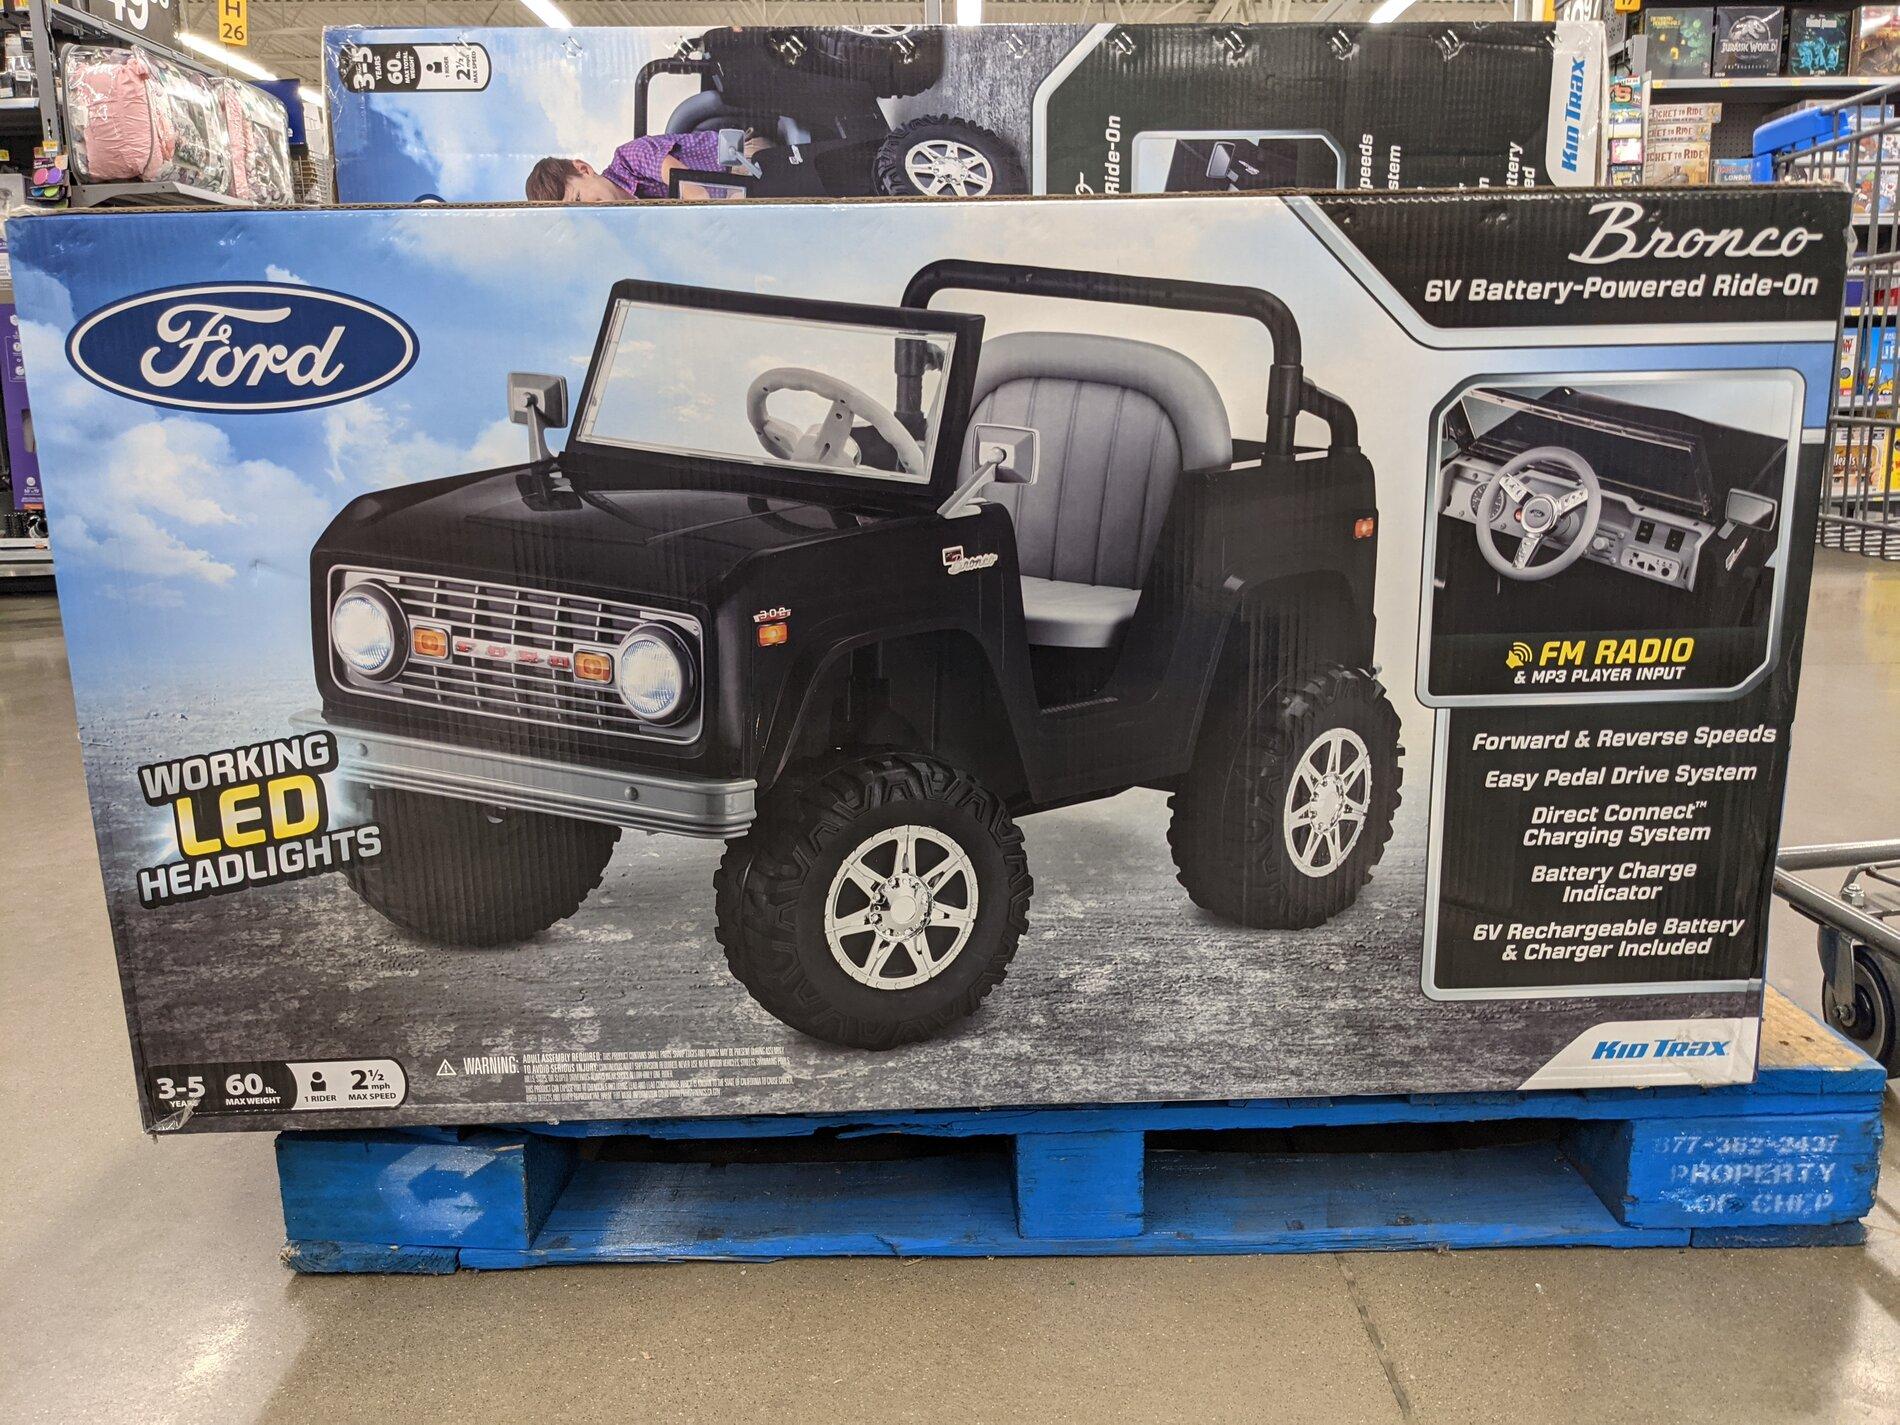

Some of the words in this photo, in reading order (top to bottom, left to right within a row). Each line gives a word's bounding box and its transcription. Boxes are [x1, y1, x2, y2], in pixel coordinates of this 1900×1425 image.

[223, 23, 245, 41] 26
[1750, 41, 1778, 53] WORLD
[374, 55, 383, 81] YEARS
[386, 59, 403, 85] 60
[1686, 106, 1704, 116] RIDE
[1104, 115, 1121, 195] Ride-On
[1357, 133, 1374, 191] peeds
[1683, 148, 1705, 159] RIDE
[1567, 201, 1823, 264] Bronco
[1424, 279, 1462, 302] 6V
[1468, 273, 1706, 305] Battery-Powered
[1712, 272, 1820, 297] Ride-On
[140, 303, 346, 387] Ford
[1538, 641, 1586, 666] FM
[1594, 637, 1696, 665] RADIO
[1514, 671, 1526, 684] &
[1531, 670, 1567, 684] MP3
[1570, 668, 1633, 683] PLAYER
[1635, 666, 1686, 681] INPUT
[1472, 730, 1569, 751] Forward
[1574, 730, 1590, 748] &
[1596, 728, 1688, 748] Reverse
[1693, 725, 1777, 748] Speeds
[141, 734, 330, 799] WORKING
[1484, 769, 1540, 792] Easy
[1544, 767, 1604, 788] Pedal
[1610, 766, 1669, 785] Drive
[1674, 764, 1758, 787] System
[176, 774, 320, 856] LED
[1531, 805, 1599, 824] Direct
[1522, 828, 1623, 849] Charging
[1628, 825, 1712, 847] System
[140, 825, 382, 902] HEADLIGHTS
[1531, 864, 1613, 885] Battery
[1618, 862, 1698, 881] Charge
[1562, 883, 1663, 903] Indicator
[1472, 923, 1504, 941] 6V
[1506, 919, 1657, 942] Rechargeable
[1662, 917, 1746, 937] Battery
[1502, 945, 1518, 962] &
[1523, 943, 1614, 962] Charger
[1617, 937, 1714, 958] Included
[463, 1056, 520, 1075] WARNING:
[157, 1076, 205, 1099] 3-5
[225, 1073, 263, 1096] 60
[371, 1083, 391, 1091] mph
[225, 1098, 246, 1106] MAX
[246, 1096, 281, 1105] WEIGHT
[311, 1094, 337, 1102] RIDER
[348, 1093, 368, 1101] MAX
[369, 1092, 397, 1100] SPEED
[1671, 1162, 1837, 1184] PROPERTY
